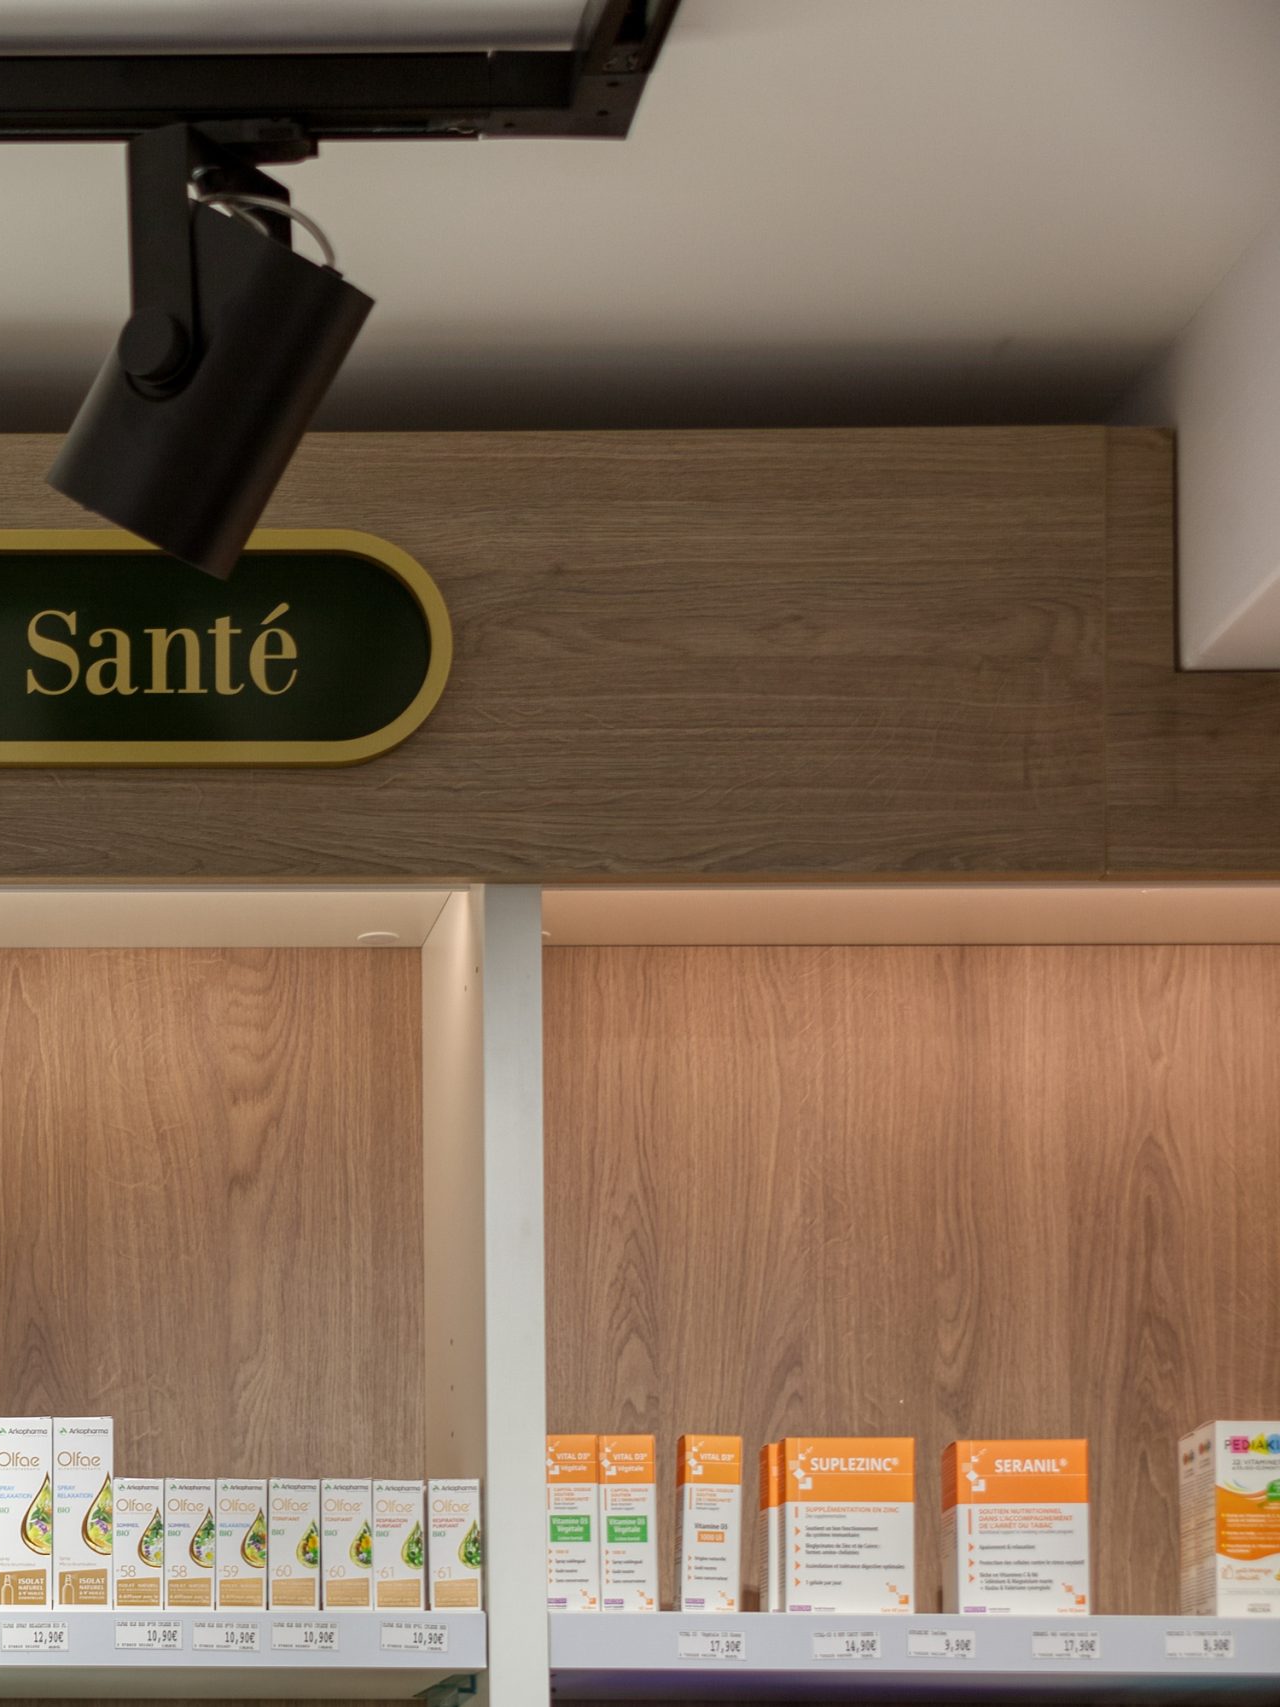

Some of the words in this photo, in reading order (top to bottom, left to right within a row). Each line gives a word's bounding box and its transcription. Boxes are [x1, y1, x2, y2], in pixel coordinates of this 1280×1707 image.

[25, 602, 298, 697] Santé
[57, 1451, 100, 1466] Olfae
[116, 1499, 153, 1511] Olfae
[168, 1499, 204, 1511] Olfae
[220, 1499, 256, 1511] Olfae
[272, 1498, 309, 1510] Olfae
[324, 1499, 361, 1511] Olfae
[376, 1499, 413, 1511] Olfae
[432, 1500, 469, 1512] Olfae
[34, 1631, 64, 1644] 12,90€
[147, 1630, 178, 1643] 10,90€
[225, 1631, 256, 1644] 10,90€
[304, 1631, 334, 1644] 10,90€
[413, 1632, 444, 1645] 10,90€
